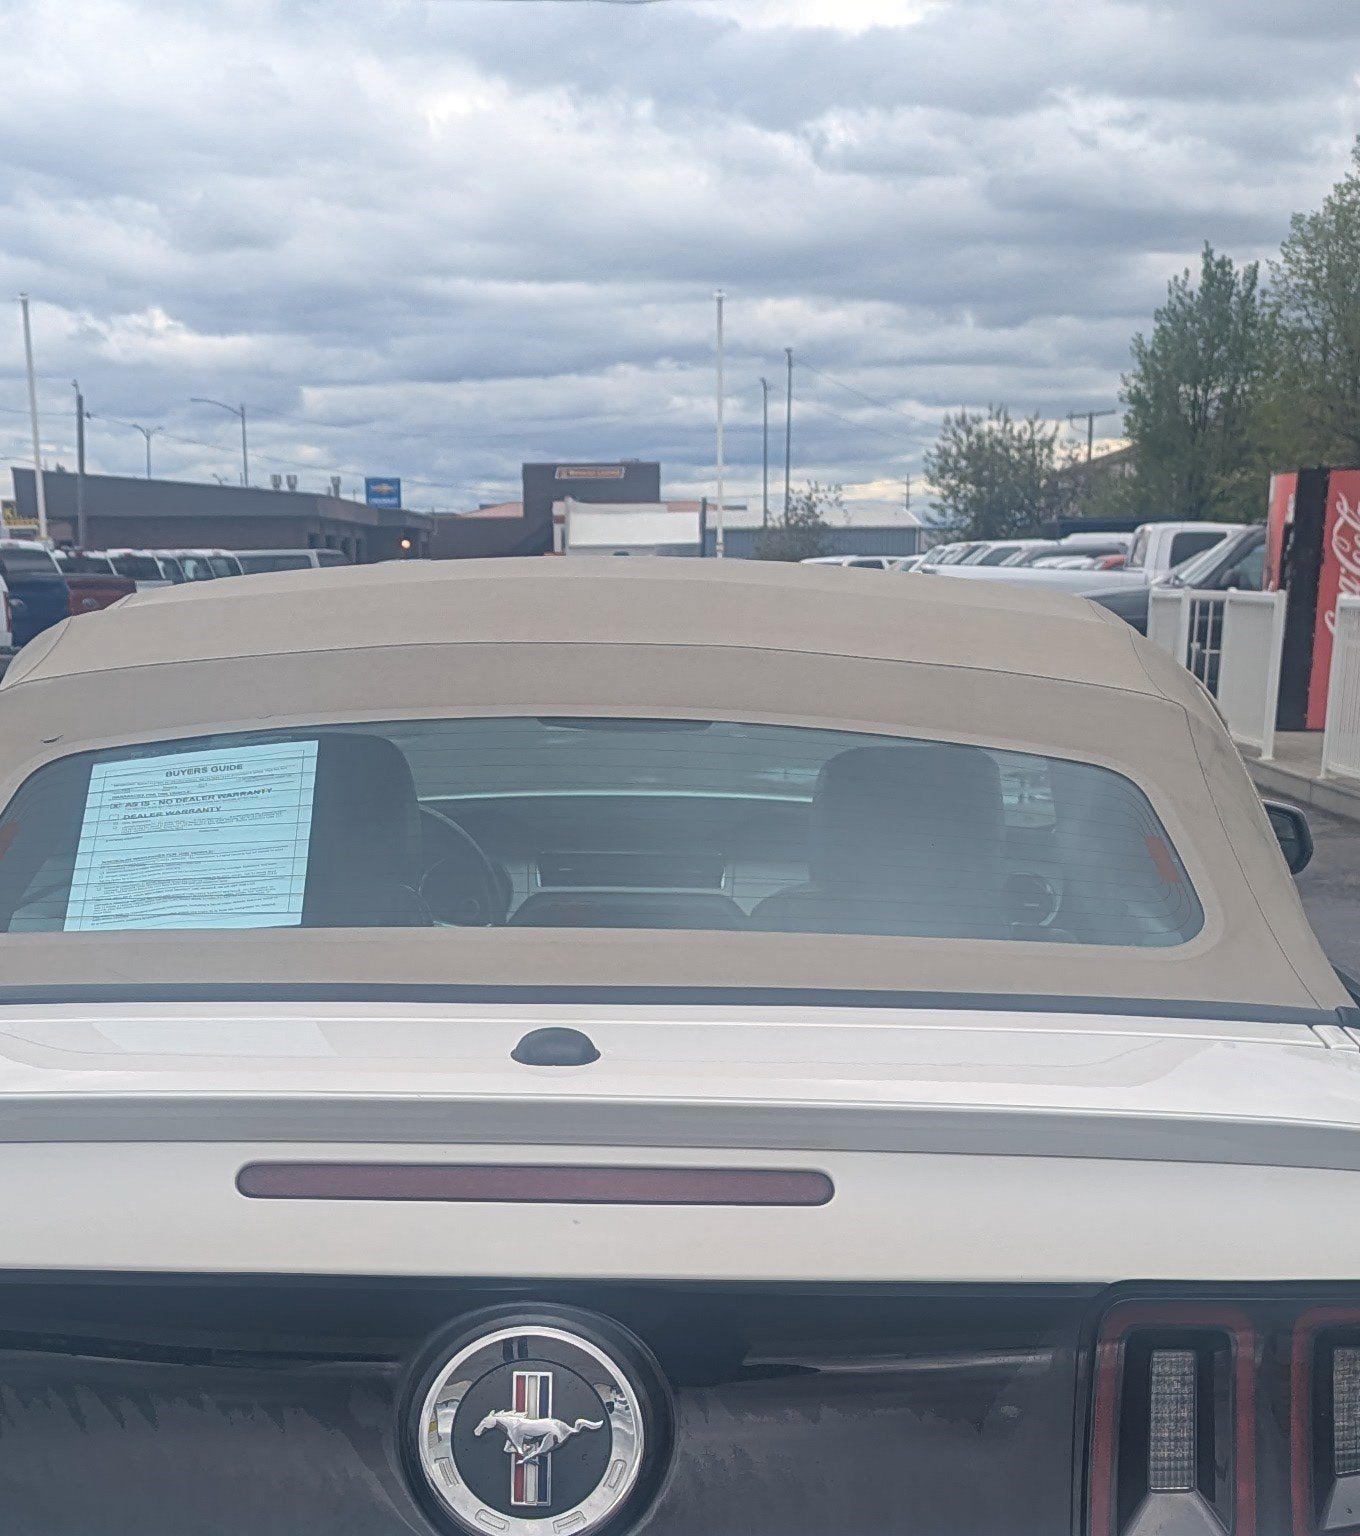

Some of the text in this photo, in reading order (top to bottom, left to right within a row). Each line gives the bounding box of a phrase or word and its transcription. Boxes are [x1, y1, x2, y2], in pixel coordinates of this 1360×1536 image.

[165, 768, 208, 778] BUYERS
[210, 764, 243, 773] GUIDE
[158, 798, 173, 806] NO
[176, 794, 215, 803] DEALER
[217, 787, 273, 800] WARRANTY
[123, 812, 163, 820] DEALER
[165, 806, 221, 816] WARRANTY
